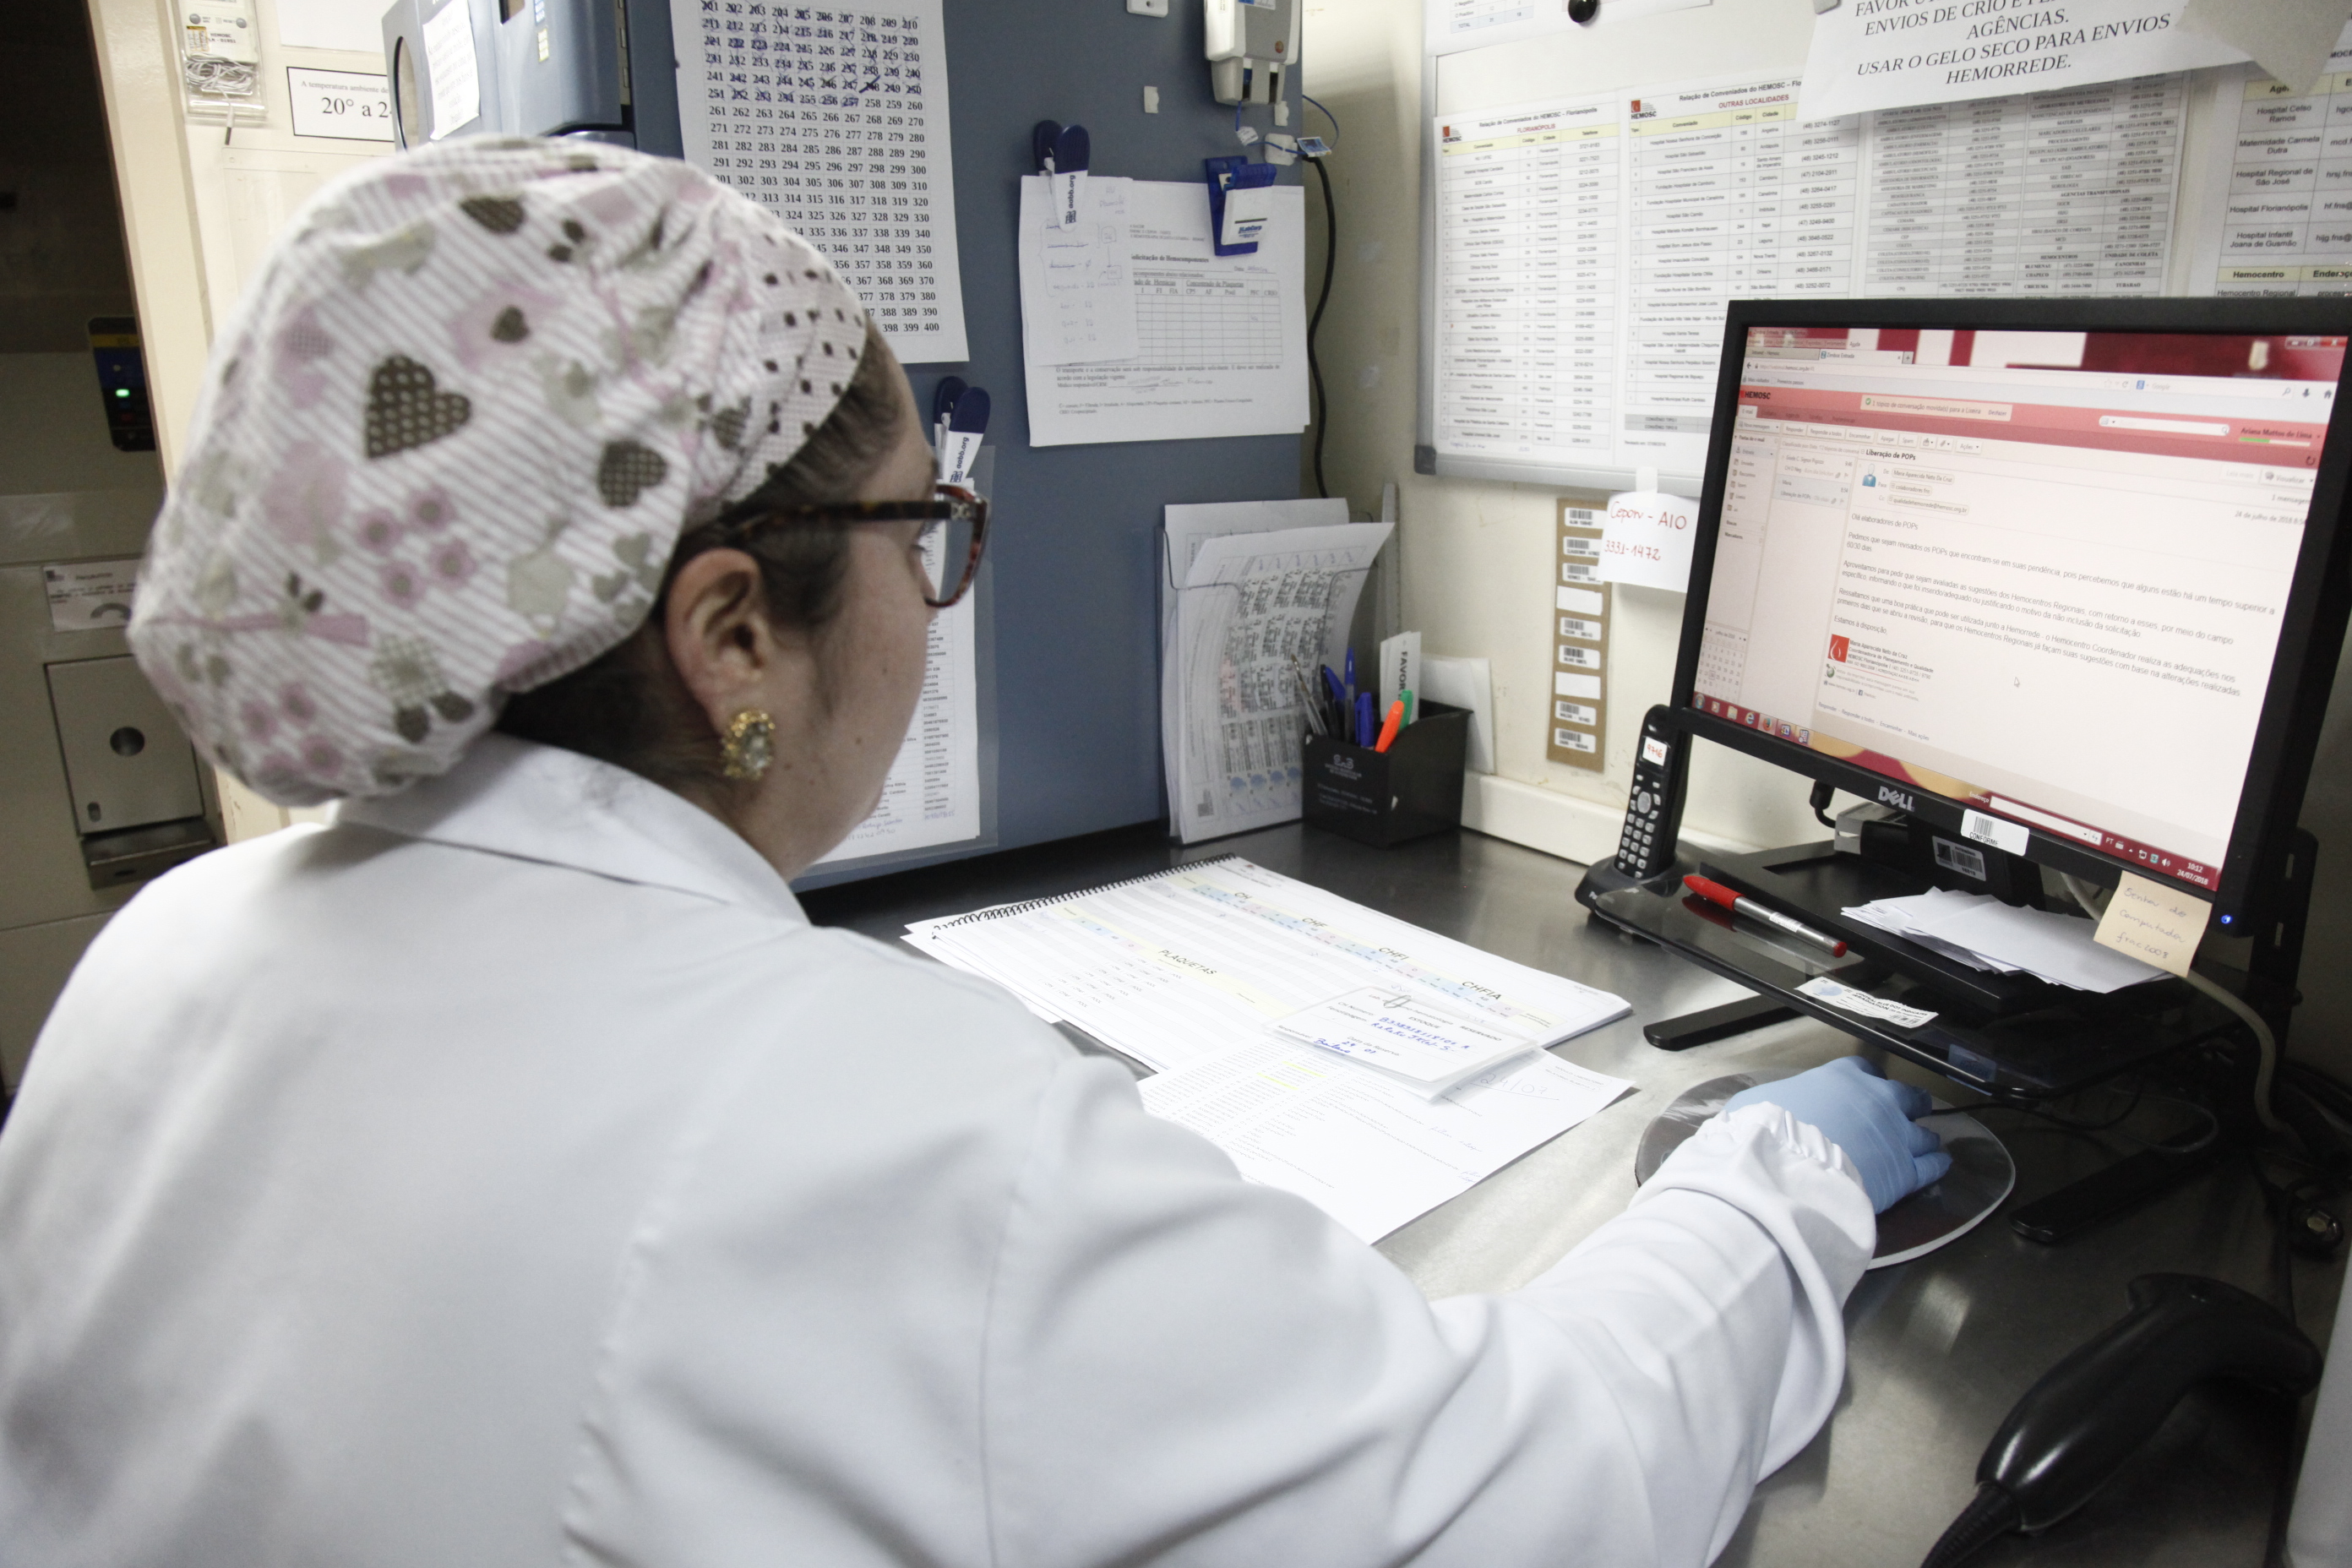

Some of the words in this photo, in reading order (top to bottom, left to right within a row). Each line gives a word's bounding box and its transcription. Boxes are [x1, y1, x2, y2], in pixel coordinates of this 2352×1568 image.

[1854, 0, 1908, 17] FAVOR
[1865, 12, 1929, 36] ENVIOS
[1932, 6, 1957, 24] DE
[1962, 0, 2006, 19] CRIO
[1966, 8, 2069, 41] AGÊNCIAS.
[1857, 57, 1903, 76] USAR
[1908, 55, 1922, 69] O
[1925, 46, 1976, 67] GELO
[1979, 38, 2030, 59] SECO
[2035, 29, 2086, 51] PARA
[2091, 13, 2171, 41] ENVIOS
[1945, 54, 2072, 84] HEMORREDE.
[308, 81, 349, 90] temperatura
[1679, 92, 1701, 102] Relação
[1710, 85, 1748, 98] Conveniados
[1749, 84, 1756, 93] do
[1757, 80, 1785, 92] HEMOSC
[321, 97, 354, 115] 20°
[362, 105, 372, 117] a
[378, 101, 392, 118] 2
[1718, 99, 1744, 110] OUTRAS
[1745, 93, 1789, 106] LOCALIDADES
[709, 105, 726, 116] 261
[732, 106, 750, 117] 262
[755, 108, 773, 118] 263
[778, 110, 796, 120] 264
[801, 111, 818, 121] 265
[823, 112, 840, 122] 266
[844, 113, 861, 123] 267
[866, 114, 882, 124] 268
[887, 116, 903, 126] 269
[908, 117, 924, 127] 270
[1631, 110, 1657, 120] HEMOSC
[2257, 106, 2288, 115] Hospital
[2289, 104, 2311, 113] Celso
[2269, 114, 2296, 123] Ramos
[2267, 146, 2288, 155] Dutra
[2236, 169, 2267, 179] Hospital
[2268, 167, 2300, 177] Regional
[2300, 167, 2313, 176] de
[2255, 177, 2270, 186] São
[1067, 174, 1077, 210] aabb.org
[762, 193, 780, 203] 313
[784, 193, 802, 204] 314
[807, 193, 824, 204] 315
[828, 194, 845, 204] 316
[850, 195, 866, 205] 317
[871, 196, 887, 206] 318
[892, 197, 908, 206] 319
[912, 197, 928, 207] 320
[2230, 205, 2260, 215] Hospital
[2261, 203, 2308, 213] Florianópolis
[2236, 231, 2268, 240] Hospital
[2230, 240, 2253, 248] Joana
[2254, 239, 2264, 248] de
[2233, 270, 2284, 279] Hemocentro
[884, 323, 899, 332] 398
[903, 323, 919, 332] 399
[923, 322, 939, 332] 400
[1744, 390, 1772, 400] HEMOSC
[956, 437, 970, 469] aabb.org
[1865, 449, 1892, 460] Liberação
[1901, 452, 1916, 460] POPs
[1851, 513, 1861, 521] Olá
[1860, 514, 1894, 526] elaboradores
[1894, 520, 1903, 528] de
[1902, 520, 1919, 531] POPs
[1843, 559, 1877, 573] Aproveitamos
[1889, 569, 1904, 578] pedir
[1915, 574, 1932, 584] sejam
[1932, 579, 1959, 589] avaliadas
[1968, 585, 1998, 597] sugestões
[1998, 591, 2010, 600] dos
[2011, 592, 2052, 608] Hemocentros
[2088, 609, 2104, 618] com
[2104, 612, 2130, 623] retorno
[2160, 624, 2175, 633] por
[2175, 627, 2194, 637] meio
[2195, 630, 2206, 640] do
[2207, 634, 2234, 645] campo
[1833, 614, 1855, 627] Estamos
[1877, 786, 1914, 812] DELL
[1968, 791, 1990, 803] Endereço
[1968, 831, 1999, 847] CONFORME
[2104, 836, 2114, 846] PT
[2186, 861, 2204, 874] 10:12
[2175, 867, 2209, 887] 24/07/2018
[1234, 891, 1252, 900] CH
[1301, 917, 1328, 928] CHF
[1378, 946, 1410, 961] CHFI
[1462, 981, 1502, 1001] CHFIA
[1157, 949, 1217, 975] PLAQUETAS
[1407, 1016, 1441, 1029] ESTOQUE
[1459, 1025, 1503, 1042] RESERVADO
